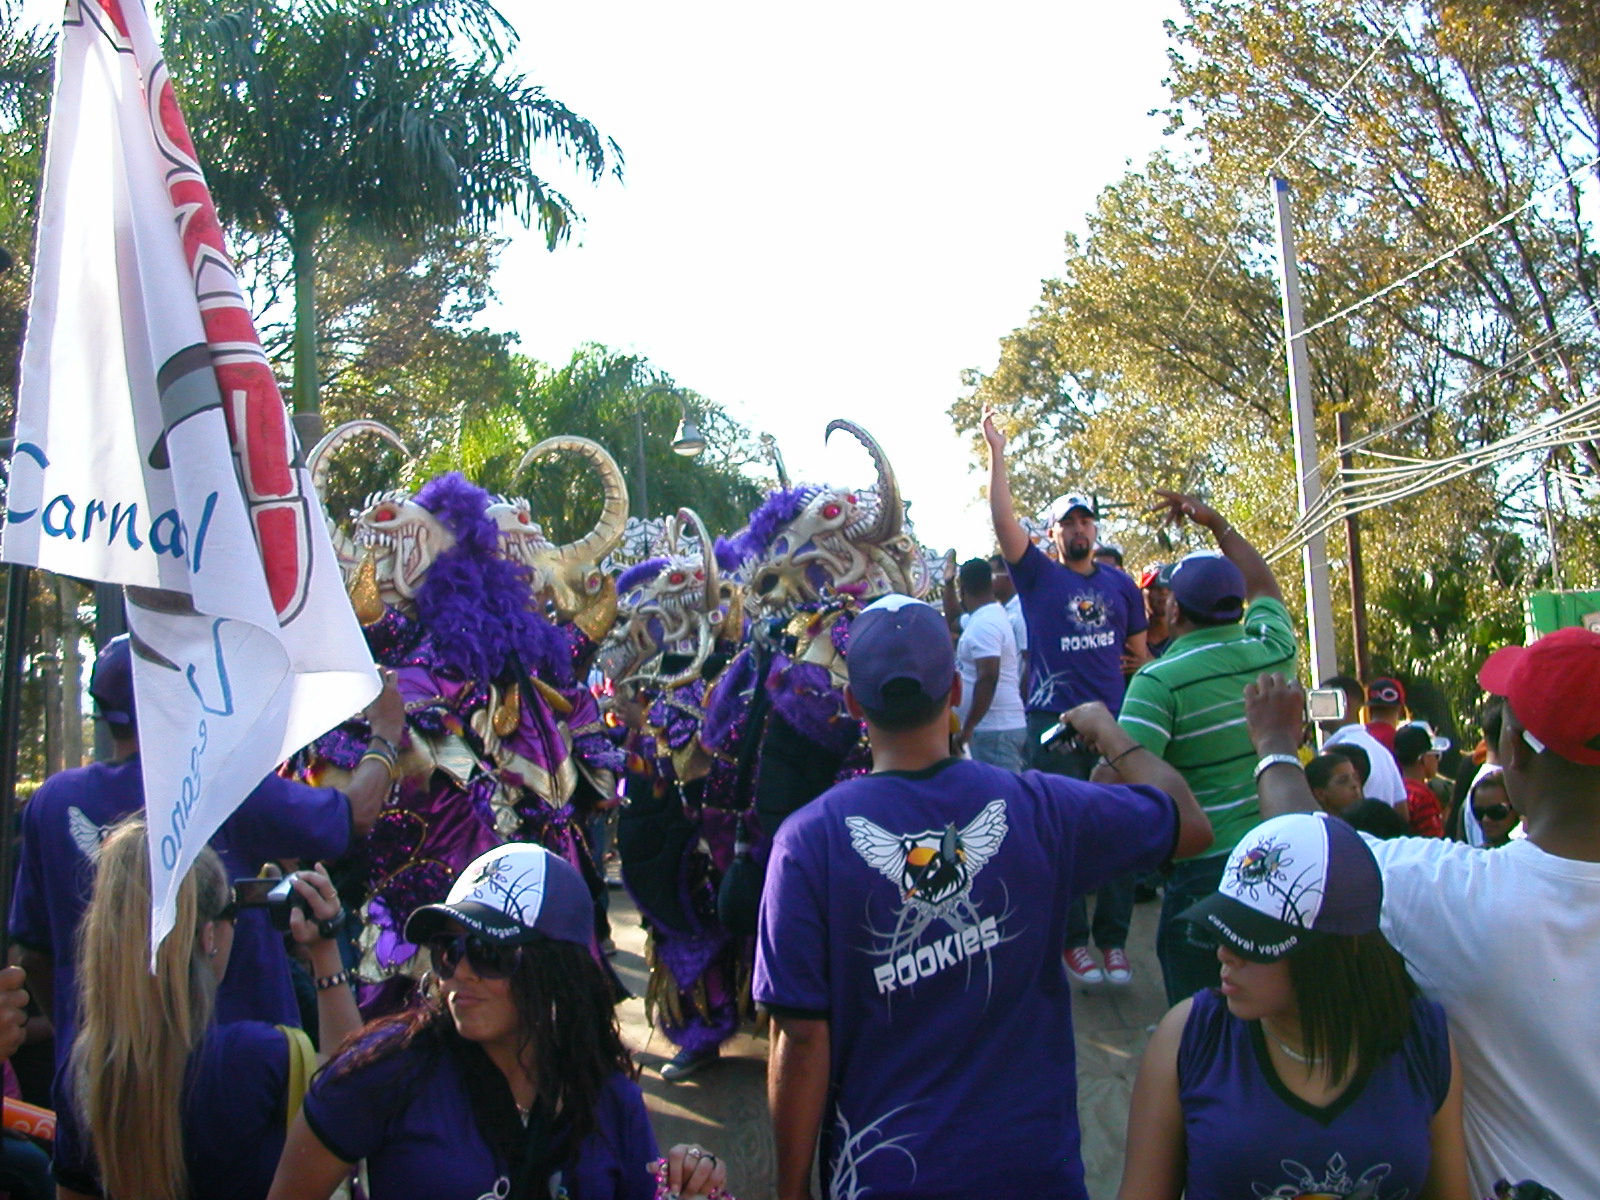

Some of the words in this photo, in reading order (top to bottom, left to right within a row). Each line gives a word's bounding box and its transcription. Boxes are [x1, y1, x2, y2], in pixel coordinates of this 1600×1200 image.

[1060, 631, 1116, 652] ROOKIES
[873, 915, 1001, 995] ROOKIES
[1208, 914, 1255, 952] carnaval
[1257, 935, 1299, 957] vegano
